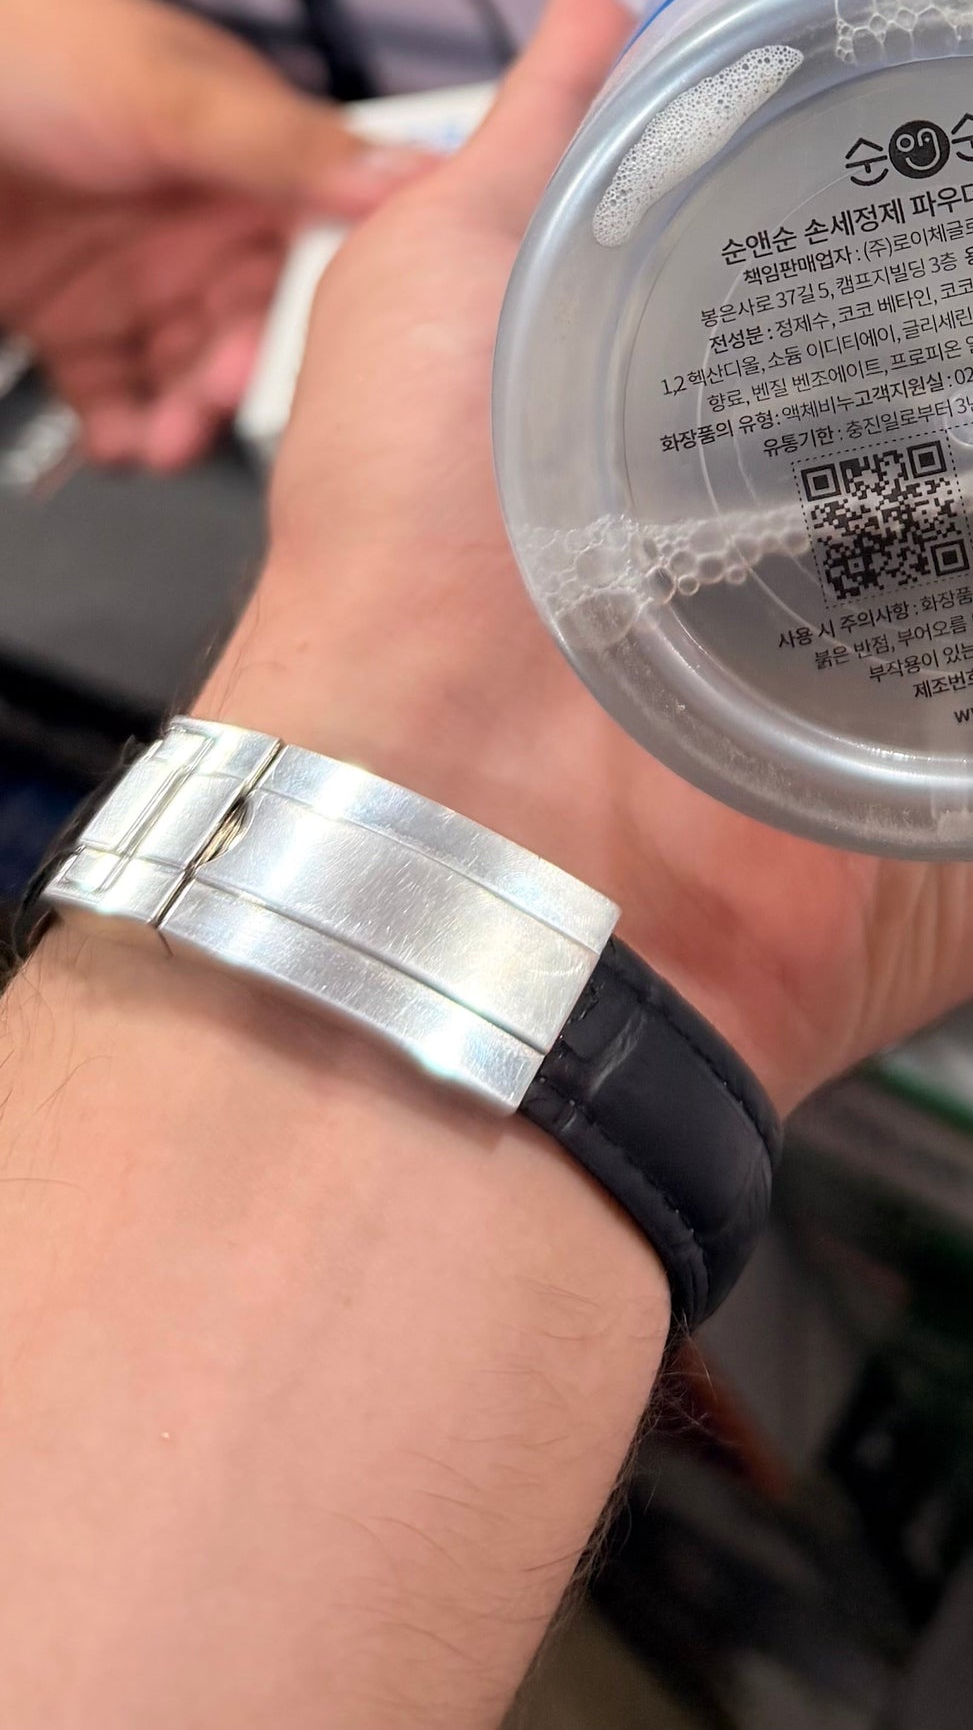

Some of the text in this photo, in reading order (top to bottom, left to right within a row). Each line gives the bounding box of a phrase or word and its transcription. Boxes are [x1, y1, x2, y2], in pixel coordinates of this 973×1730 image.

[721, 226, 798, 266] 순앤순
[804, 197, 906, 246] 손세정제
[700, 294, 775, 328] 봉은사로
[775, 282, 816, 309] 37길
[835, 257, 926, 296] 캠프지빌딩
[928, 252, 958, 274] 3층
[742, 245, 853, 286] 책임판매업자
[708, 325, 764, 355] 전성분
[774, 311, 836, 339] 정제수,
[837, 301, 875, 324] 코코
[876, 286, 938, 314] 베타인,
[767, 345, 802, 369] 소듐
[806, 323, 902, 359] 이디티에이,
[706, 389, 750, 413] 향료,
[751, 377, 789, 402] 벤질
[791, 358, 889, 393] 벤조에이트,
[889, 339, 962, 371] 프로피온
[659, 419, 734, 453] 화장품의
[763, 424, 835, 458] 유통기한
[846, 398, 954, 440] 충진일로부터
[778, 626, 813, 649] 사용
[818, 619, 836, 639] 시
[840, 600, 910, 634] 주의사항
[920, 586, 973, 612] 화장품
[814, 646, 849, 670] 붉은
[853, 633, 895, 660] 반점,
[897, 614, 967, 647] 부어오름
[869, 649, 940, 683] 부작용이
